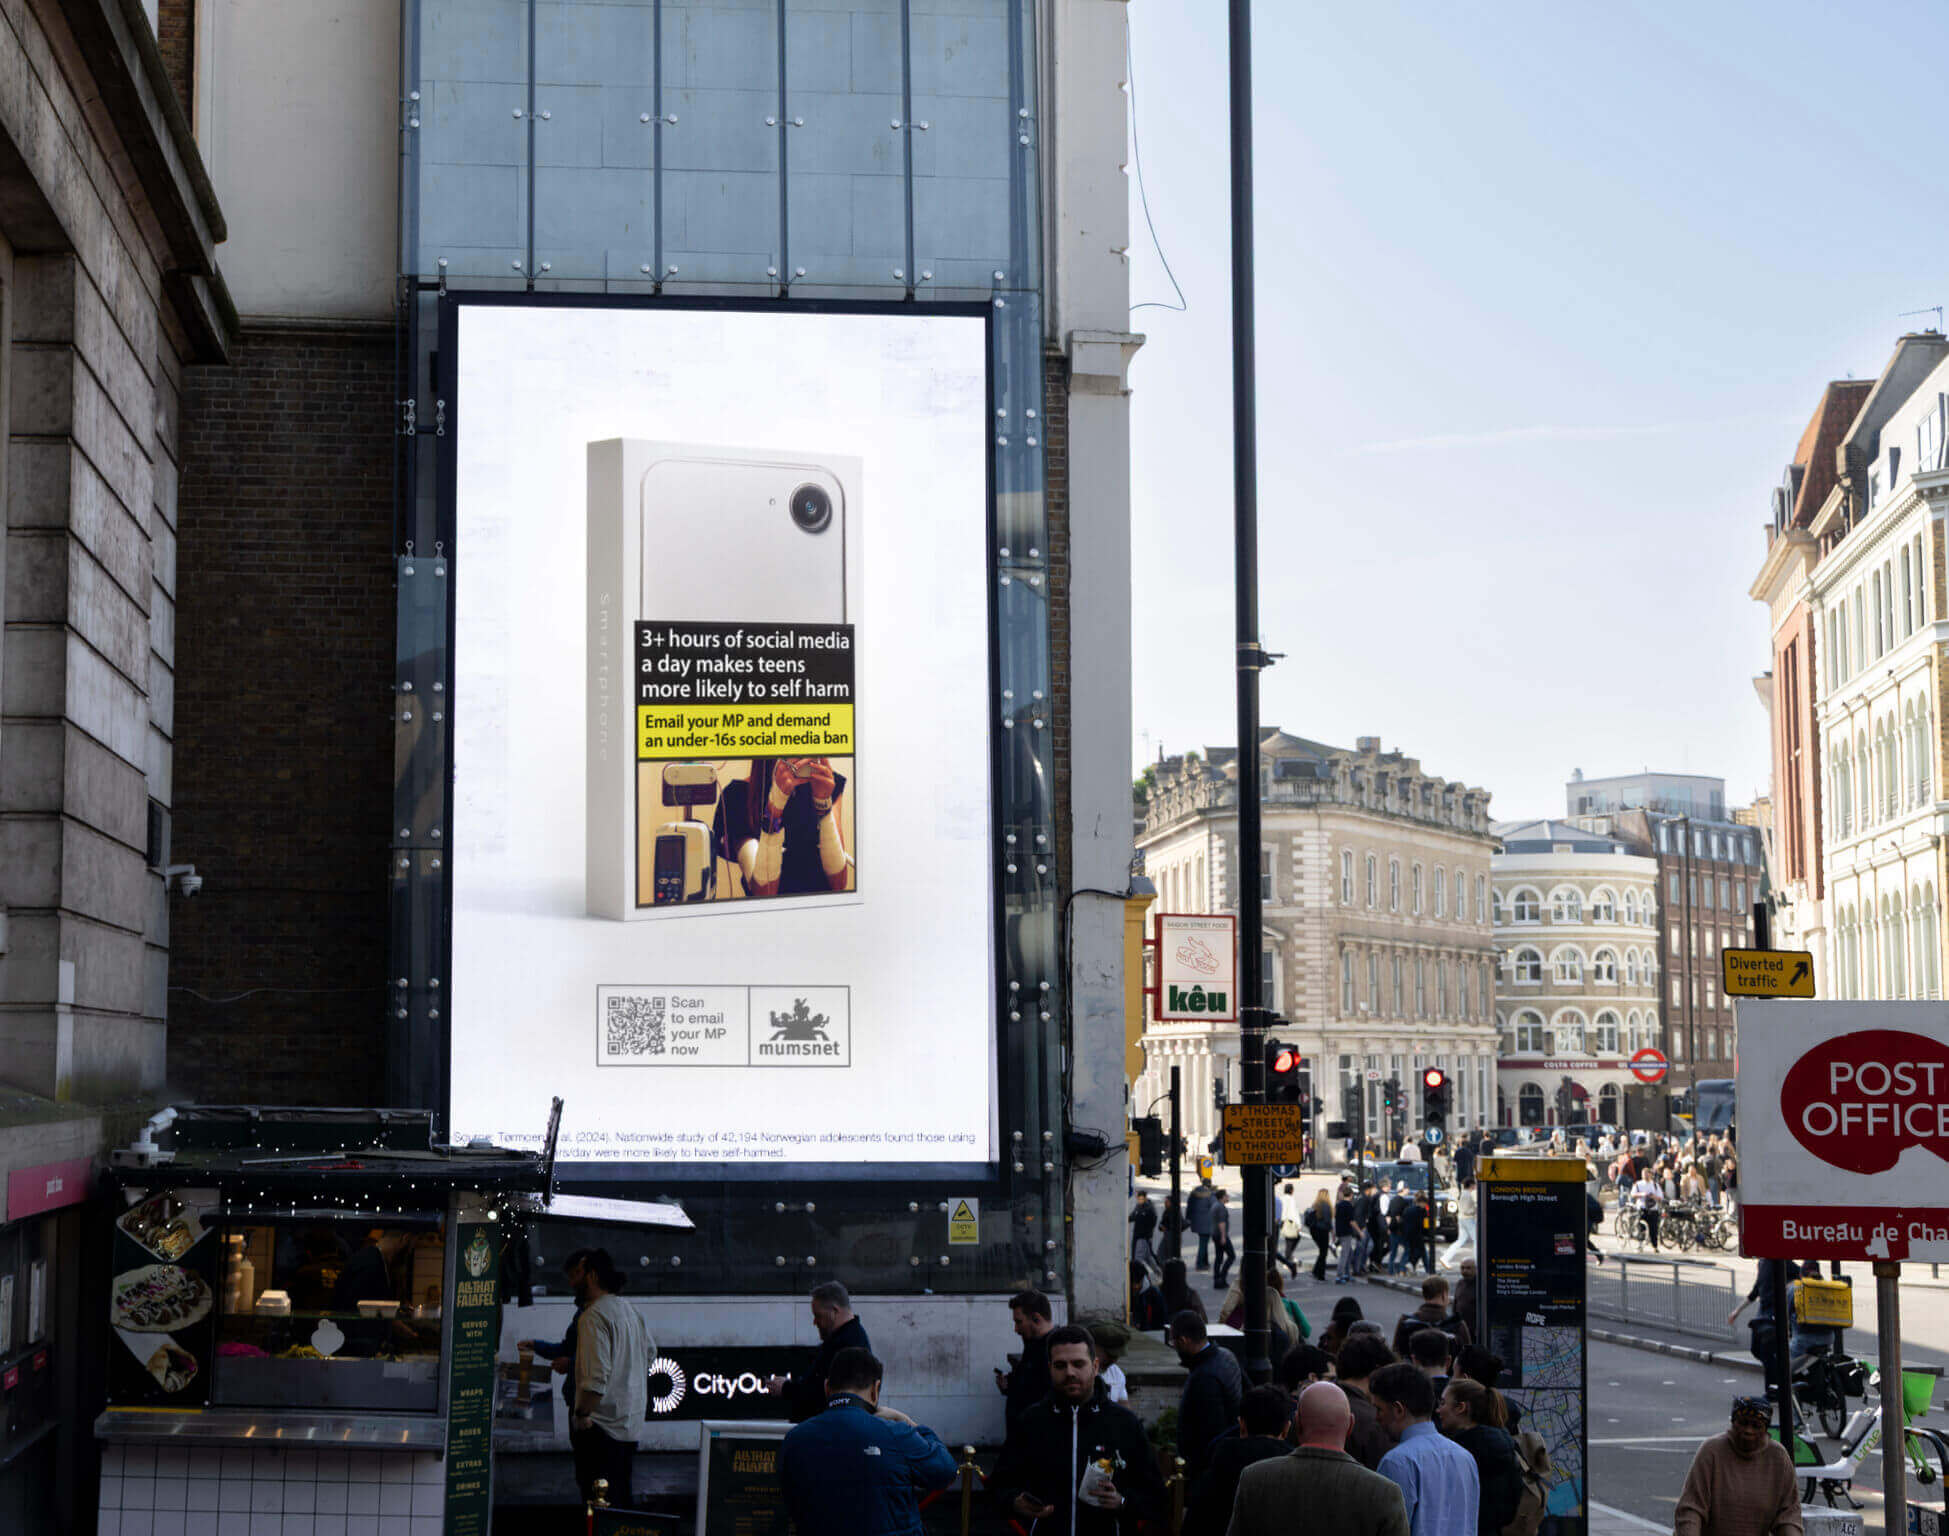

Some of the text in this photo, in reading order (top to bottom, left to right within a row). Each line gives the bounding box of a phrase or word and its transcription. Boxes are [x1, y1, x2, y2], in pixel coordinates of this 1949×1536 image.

[641, 628, 850, 649] 3+ hours of social media
[641, 654, 806, 677] a day makes teens
[641, 679, 849, 702] more likely to self harm
[645, 712, 831, 731] Email your MP and demand
[645, 731, 848, 747] an under-16s social media ban
[1729, 956, 1784, 972] Diverted
[1737, 974, 1778, 988] traffic
[671, 996, 704, 1008] Scan
[1169, 984, 1227, 1012] kêu
[671, 1012, 724, 1024] to email
[671, 1028, 727, 1041] your MP
[671, 1045, 699, 1056] now
[758, 1041, 840, 1056] mumsnet
[1830, 1061, 1945, 1097] POST
[1230, 1106, 1295, 1116] ST THOMAS
[1241, 1118, 1283, 1128] STREET
[1802, 1101, 1949, 1138] OFFICE
[616, 1132, 674, 1143] Nationwide
[676, 1132, 704, 1145] study
[708, 1132, 719, 1143] of
[721, 1132, 758, 1144] 42,194
[761, 1132, 816, 1145] Norwegian
[819, 1132, 880, 1144] adolescents
[885, 1132, 913, 1143] found
[916, 1132, 945, 1143] those
[948, 1132, 976, 1145] using
[1241, 1129, 1286, 1139] CLOSED
[595, 1148, 621, 1158] were
[624, 1148, 650, 1158] more
[653, 1147, 677, 1160] likely
[681, 1147, 691, 1158] to
[694, 1147, 719, 1158] have
[721, 1147, 787, 1158] self-harmed.
[1227, 1142, 1300, 1151] TO THROUGH
[1241, 1152, 1287, 1162] TRAFFIC
[1491, 1193, 1558, 1202] Borough High Street
[1782, 1219, 1864, 1242] Bureau
[1872, 1222, 1899, 1242] de
[456, 1292, 496, 1307] FALAFEL
[693, 1370, 792, 1400] CityOu
